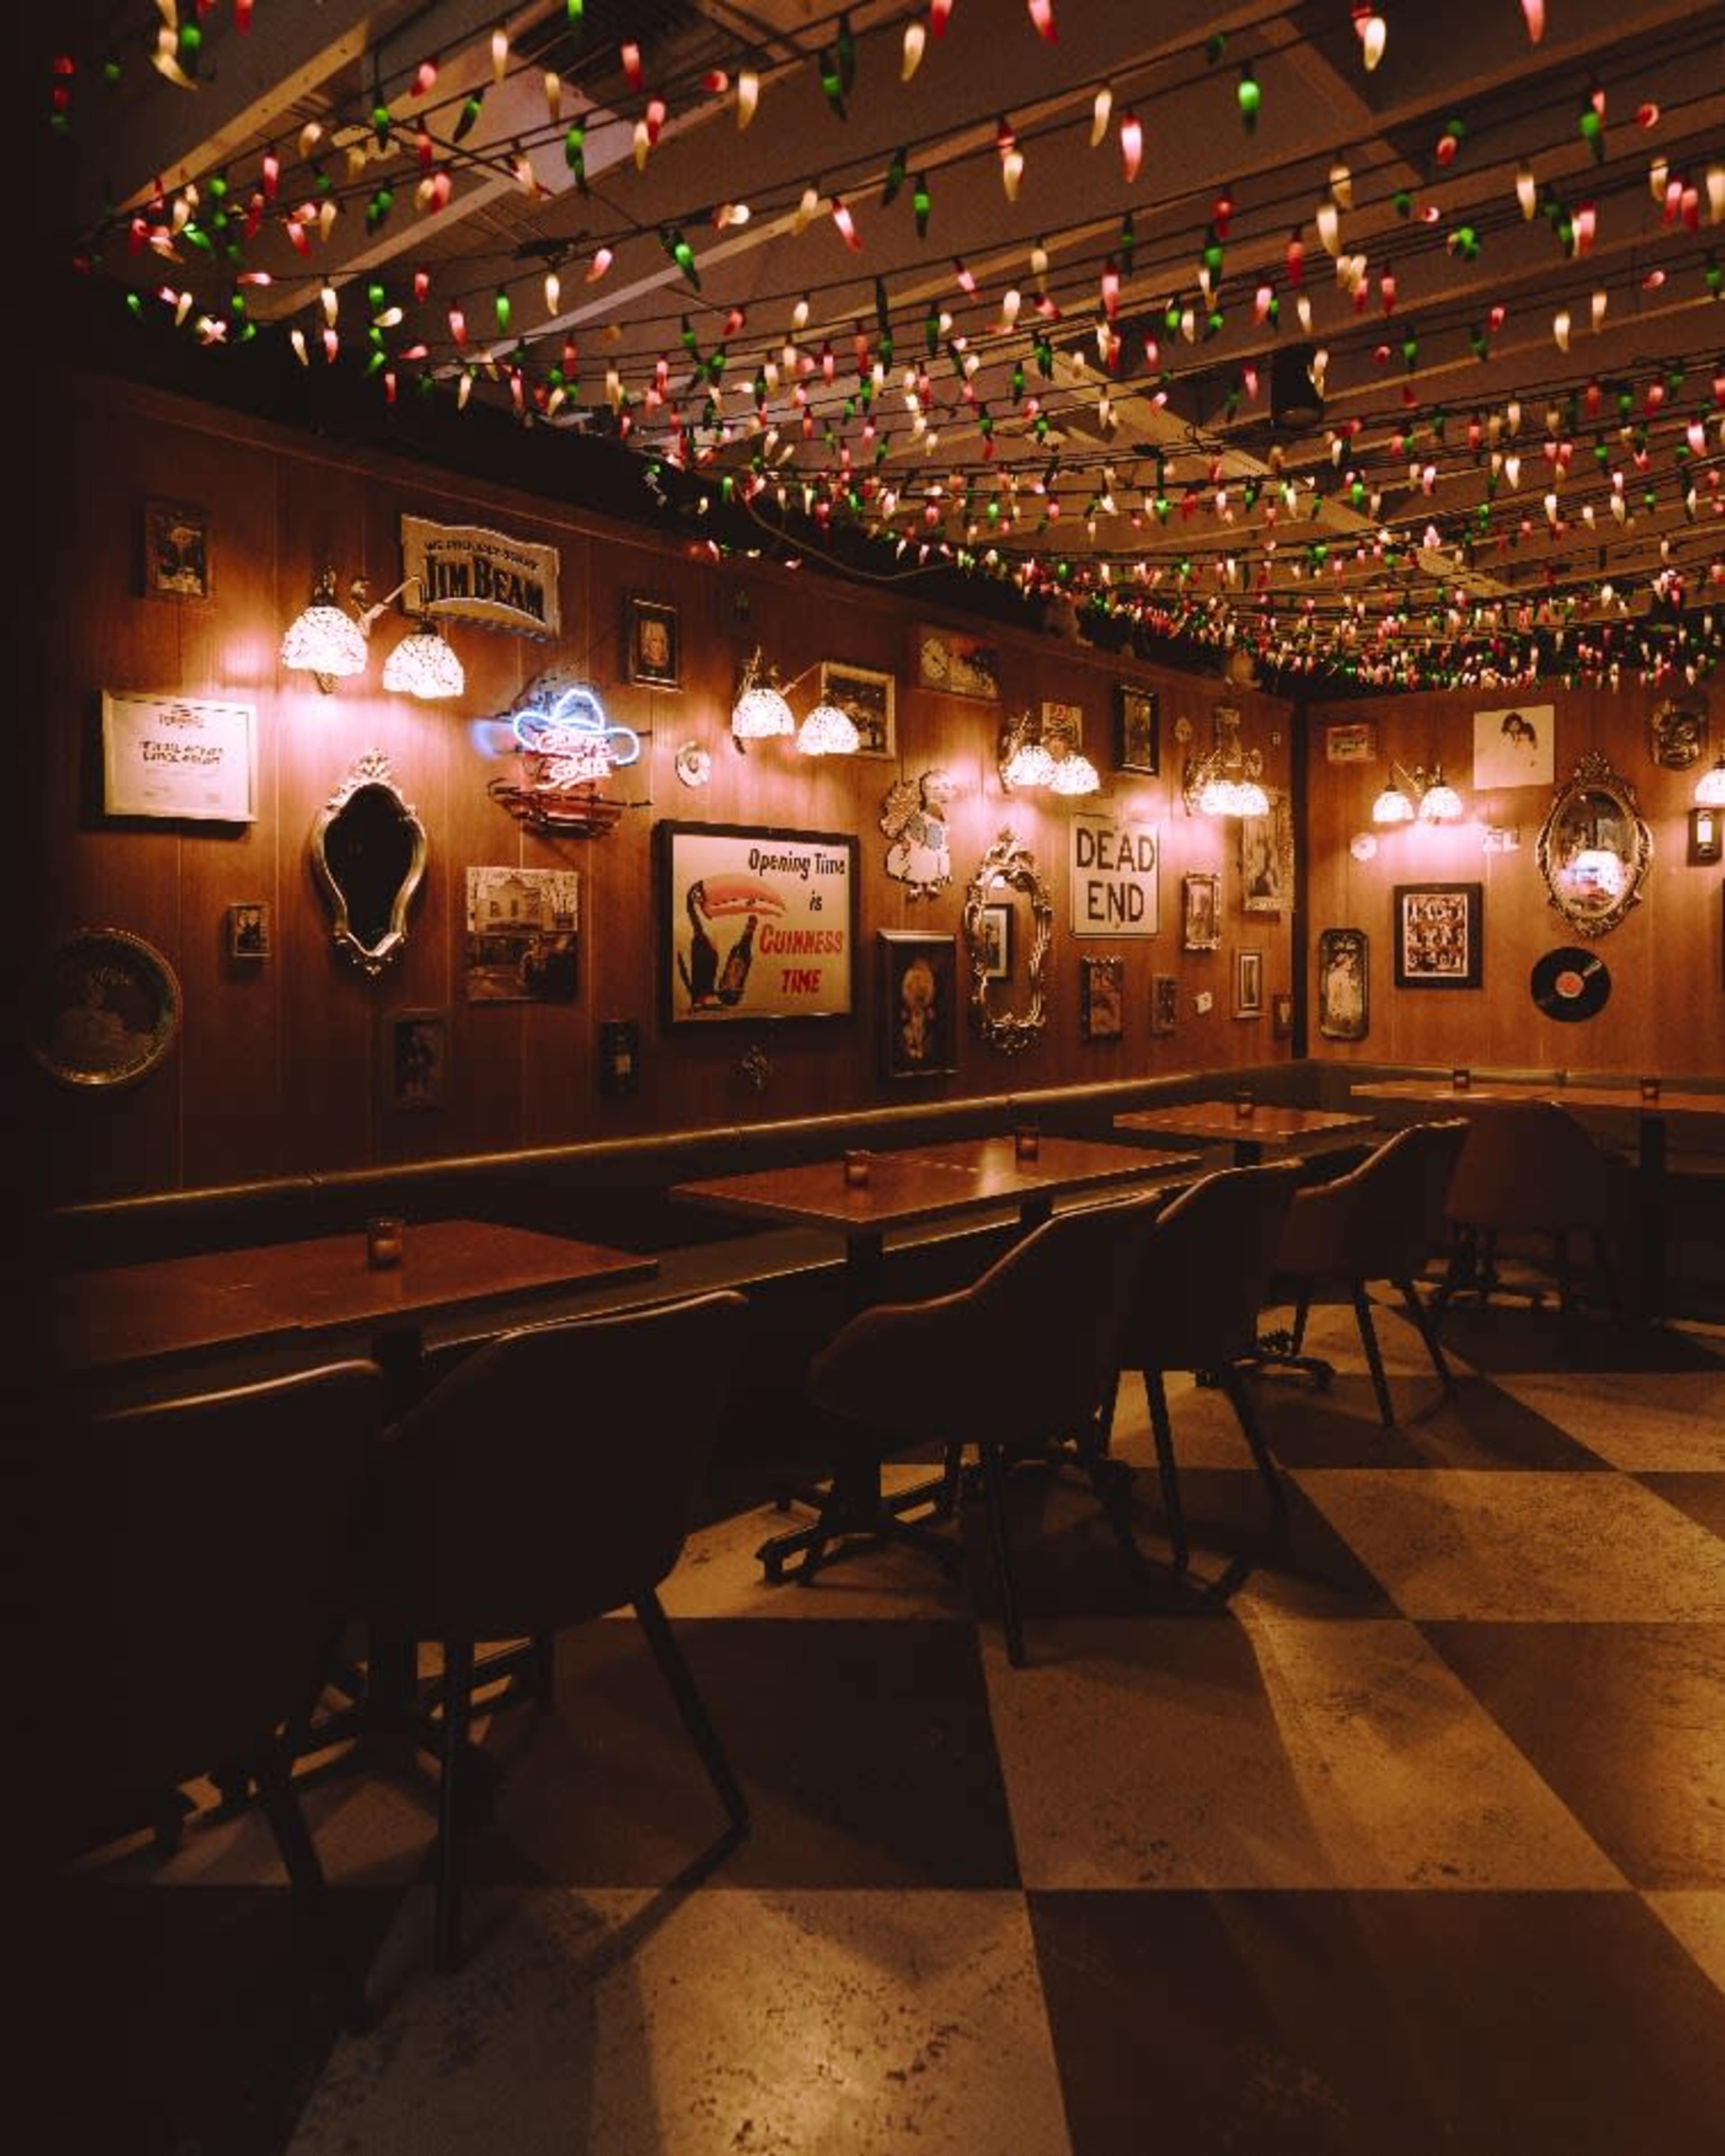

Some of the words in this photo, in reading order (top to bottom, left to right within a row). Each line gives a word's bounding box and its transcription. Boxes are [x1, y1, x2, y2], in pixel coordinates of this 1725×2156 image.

[424, 555, 469, 602] JIM
[473, 554, 544, 623] BEAM
[749, 848, 810, 880] Opening
[814, 853, 845, 875] Time
[1076, 828, 1155, 872] DEAD
[809, 891, 823, 911] is
[1087, 880, 1144, 923] END
[760, 924, 843, 955] GUINNESS
[782, 968, 822, 994] TIME
